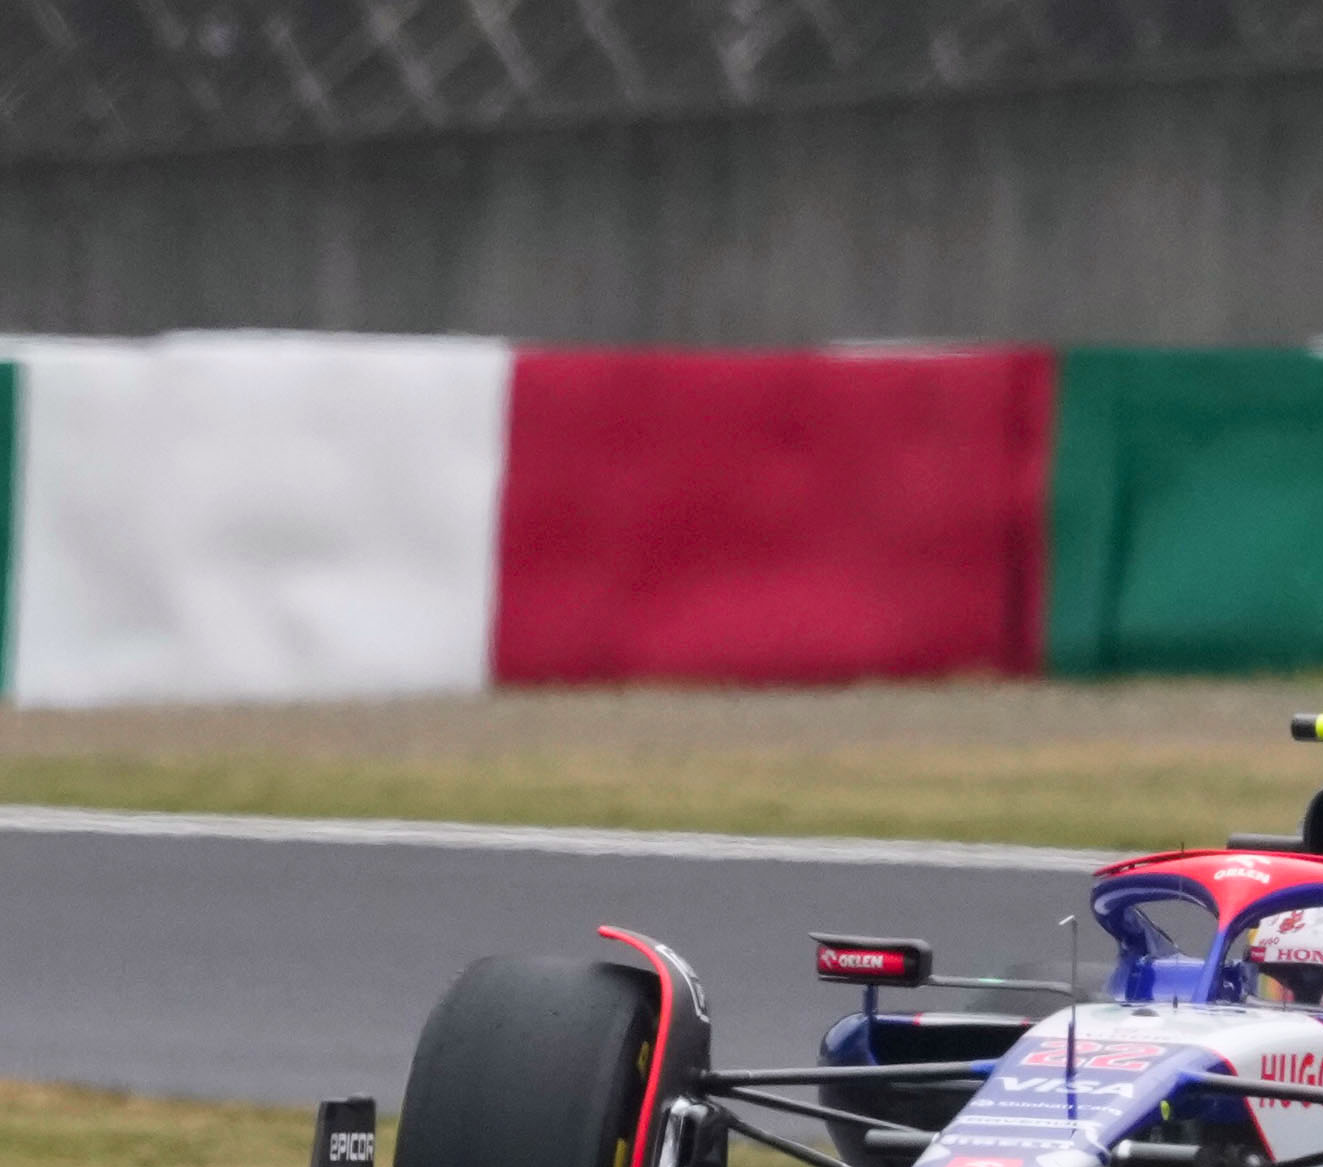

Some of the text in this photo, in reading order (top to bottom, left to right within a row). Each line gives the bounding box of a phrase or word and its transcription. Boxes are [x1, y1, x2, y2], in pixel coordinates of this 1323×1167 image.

[1214, 867, 1270, 883] ORLEN
[1020, 1039, 1167, 1072] 22
[998, 1076, 1134, 1098] VISA
